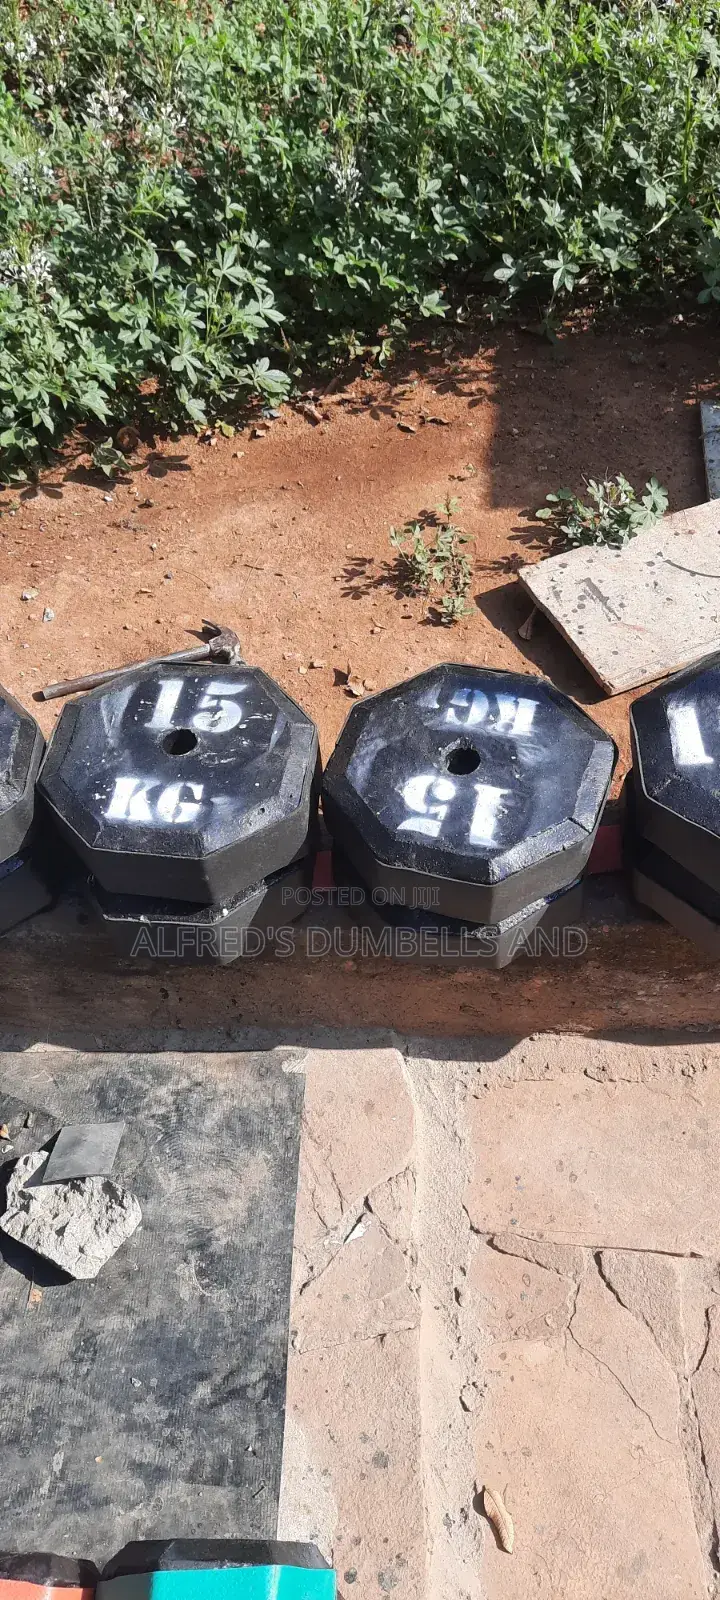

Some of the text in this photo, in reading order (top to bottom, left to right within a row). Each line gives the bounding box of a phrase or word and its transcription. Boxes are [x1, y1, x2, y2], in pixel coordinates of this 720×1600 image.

[144, 679, 248, 733] 15
[668, 701, 720, 765] 1
[104, 776, 205, 824] KG
[397, 775, 511, 848] 15
